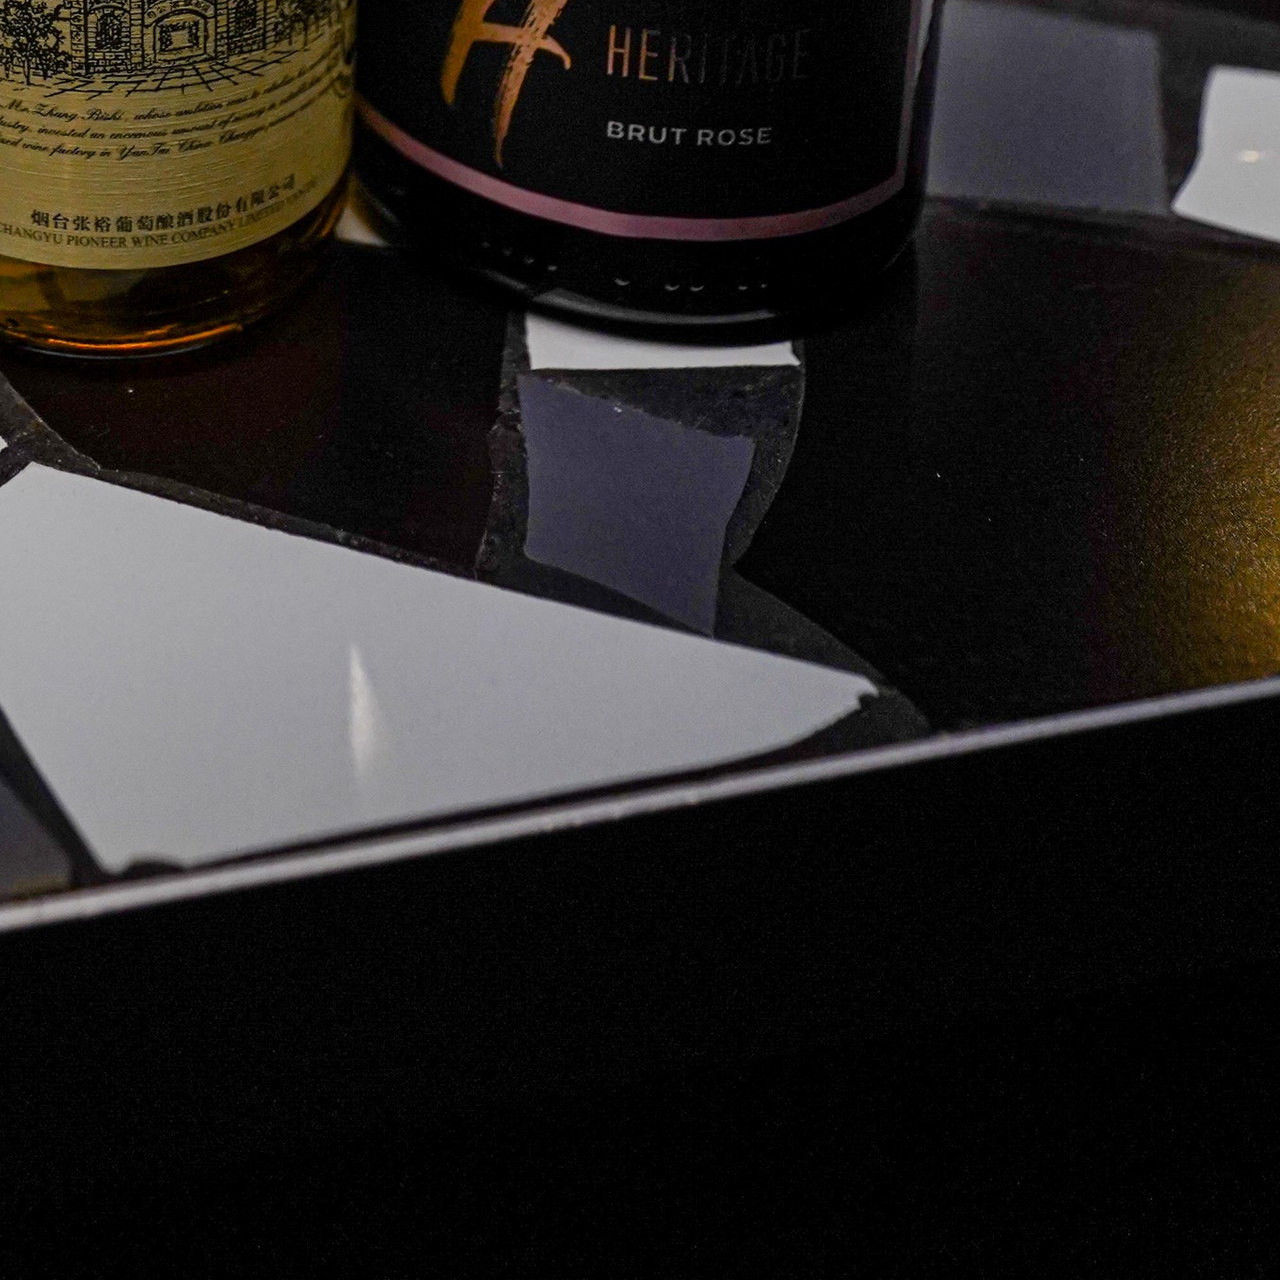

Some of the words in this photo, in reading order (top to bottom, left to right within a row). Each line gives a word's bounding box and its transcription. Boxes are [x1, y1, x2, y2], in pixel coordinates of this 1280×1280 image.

[606, 120, 688, 146] BRUT
[696, 127, 773, 147] ROSE
[66, 234, 127, 248] PIONEER
[131, 233, 169, 248] WINE
